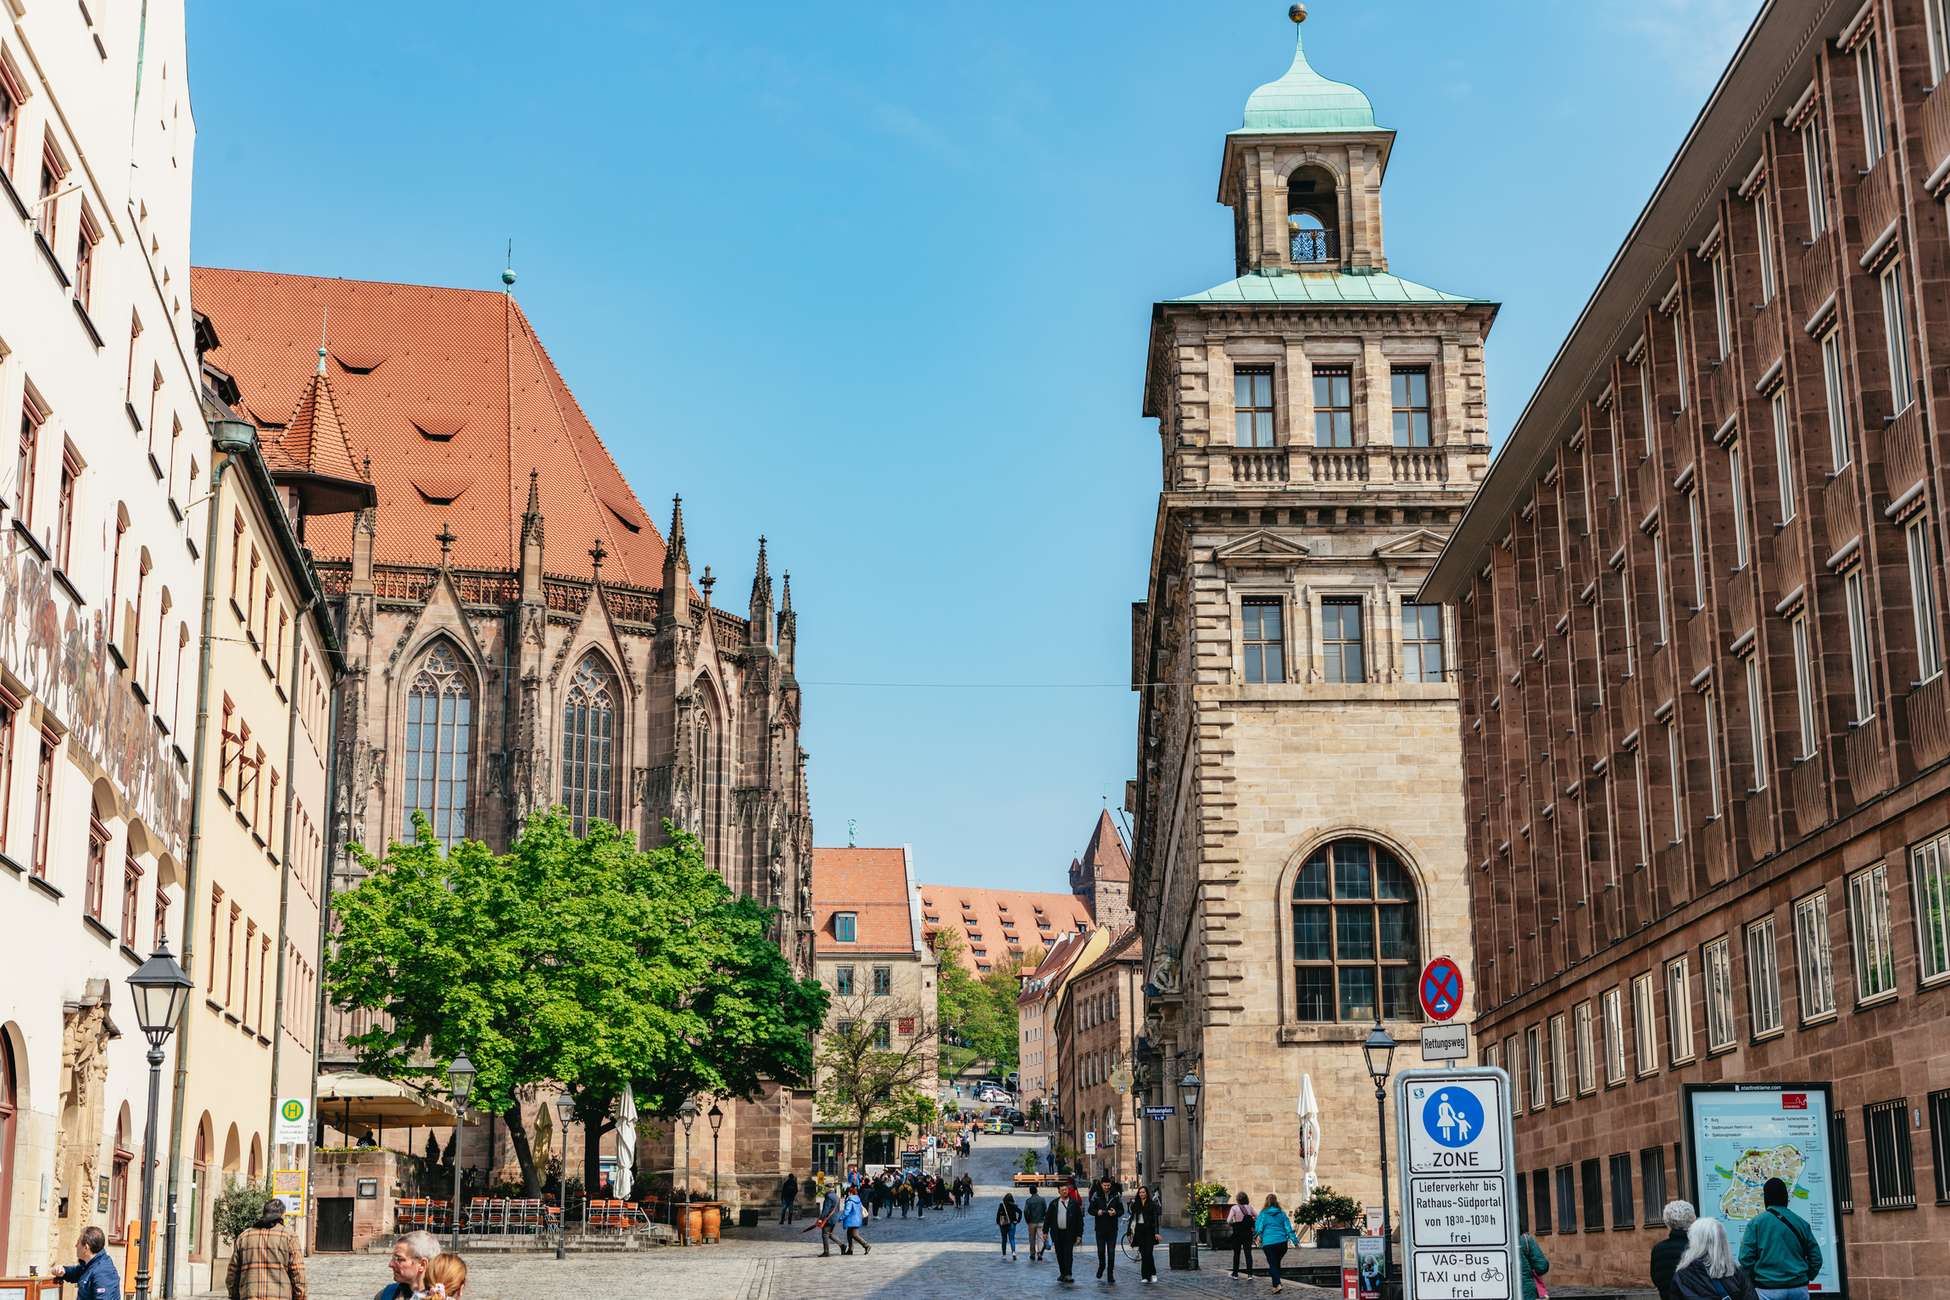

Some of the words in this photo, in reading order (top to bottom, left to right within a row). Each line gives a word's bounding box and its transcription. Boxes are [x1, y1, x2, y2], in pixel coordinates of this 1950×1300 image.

[1424, 1038, 1465, 1050] Rettungsweg
[288, 1104, 298, 1117] H
[1432, 1151, 1480, 1167] ZONE
[1419, 1181, 1480, 1193] Lieferverkehr
[1483, 1180, 1497, 1191] bis
[1416, 1196, 1502, 1210] Rathaus-Südportal
[1425, 1218, 1441, 1227] von
[1450, 1232, 1471, 1243] frei
[1432, 1253, 1490, 1265] VAG-Bus
[1420, 1271, 1448, 1283] TAXI
[1453, 1271, 1476, 1282] und
[1452, 1286, 1474, 1298] frei
